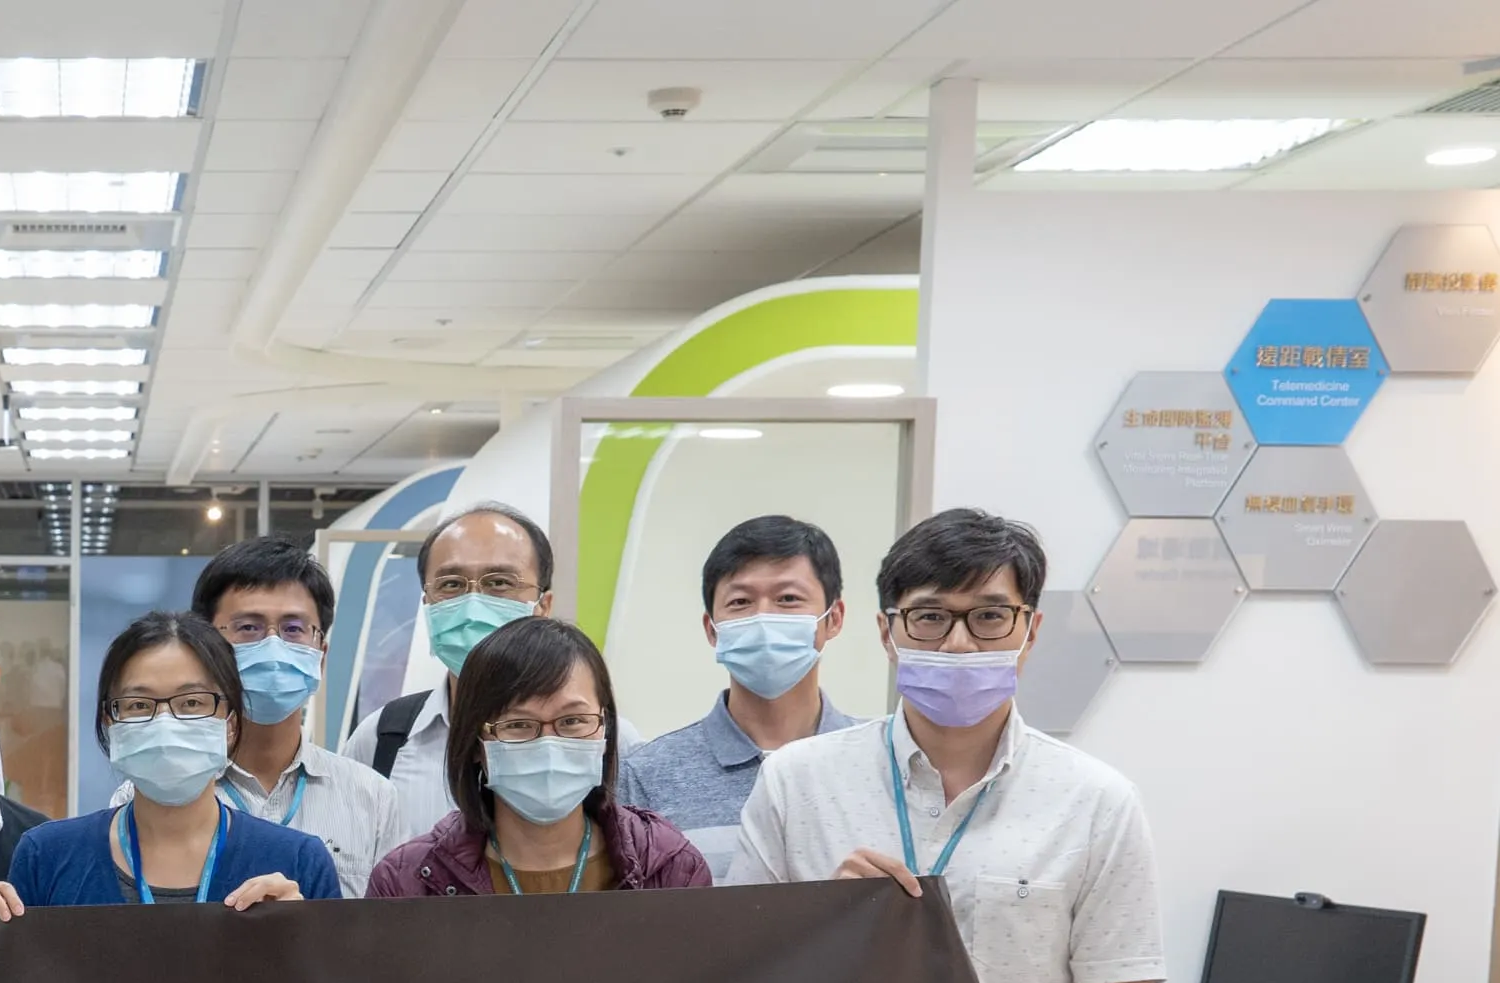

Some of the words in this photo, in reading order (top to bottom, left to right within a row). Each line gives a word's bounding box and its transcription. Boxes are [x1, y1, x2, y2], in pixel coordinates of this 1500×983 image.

[1271, 380, 1350, 391] Telemedicine
[1257, 395, 1318, 406] Command
[1321, 395, 1359, 406] Center
